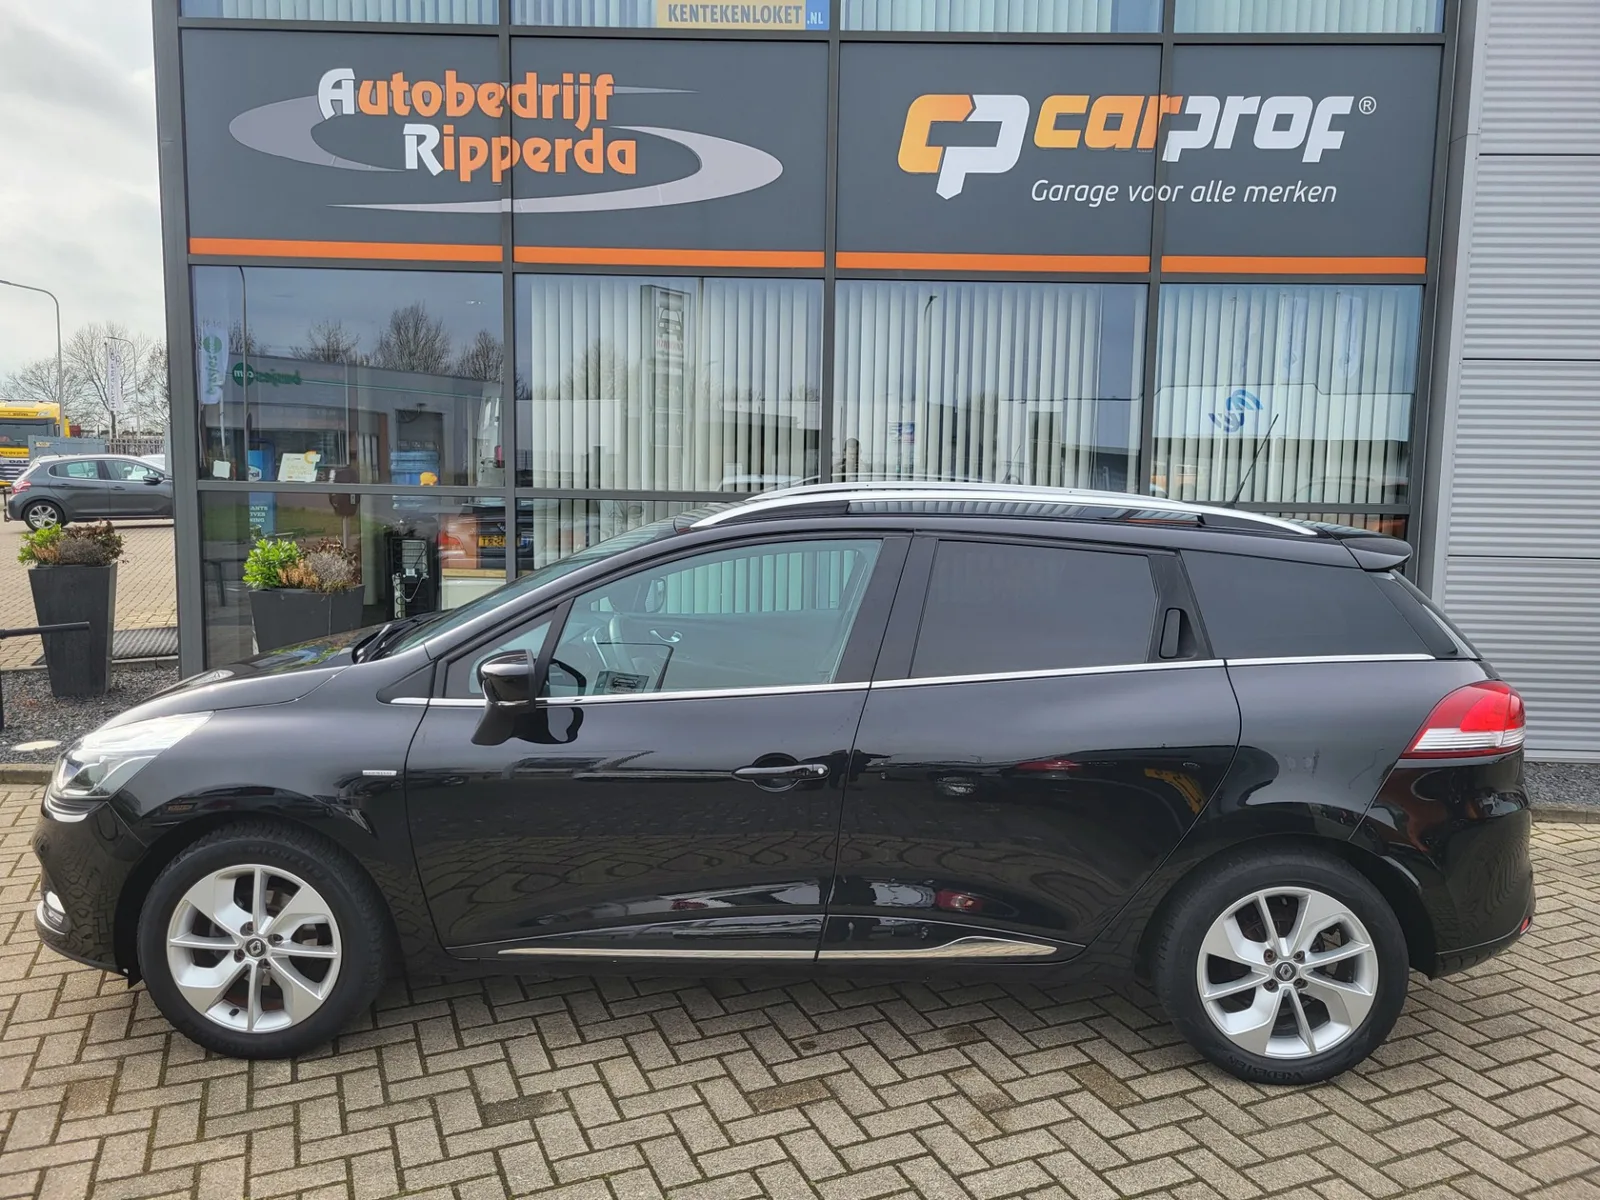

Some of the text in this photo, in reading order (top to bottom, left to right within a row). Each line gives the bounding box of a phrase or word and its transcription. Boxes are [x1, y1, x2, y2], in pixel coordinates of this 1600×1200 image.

[317, 67, 615, 130] Autobedrijf
[1033, 94, 1356, 164] carprof
[403, 122, 637, 184] Ripperda
[1031, 178, 1338, 209] Garage voor alle merken
